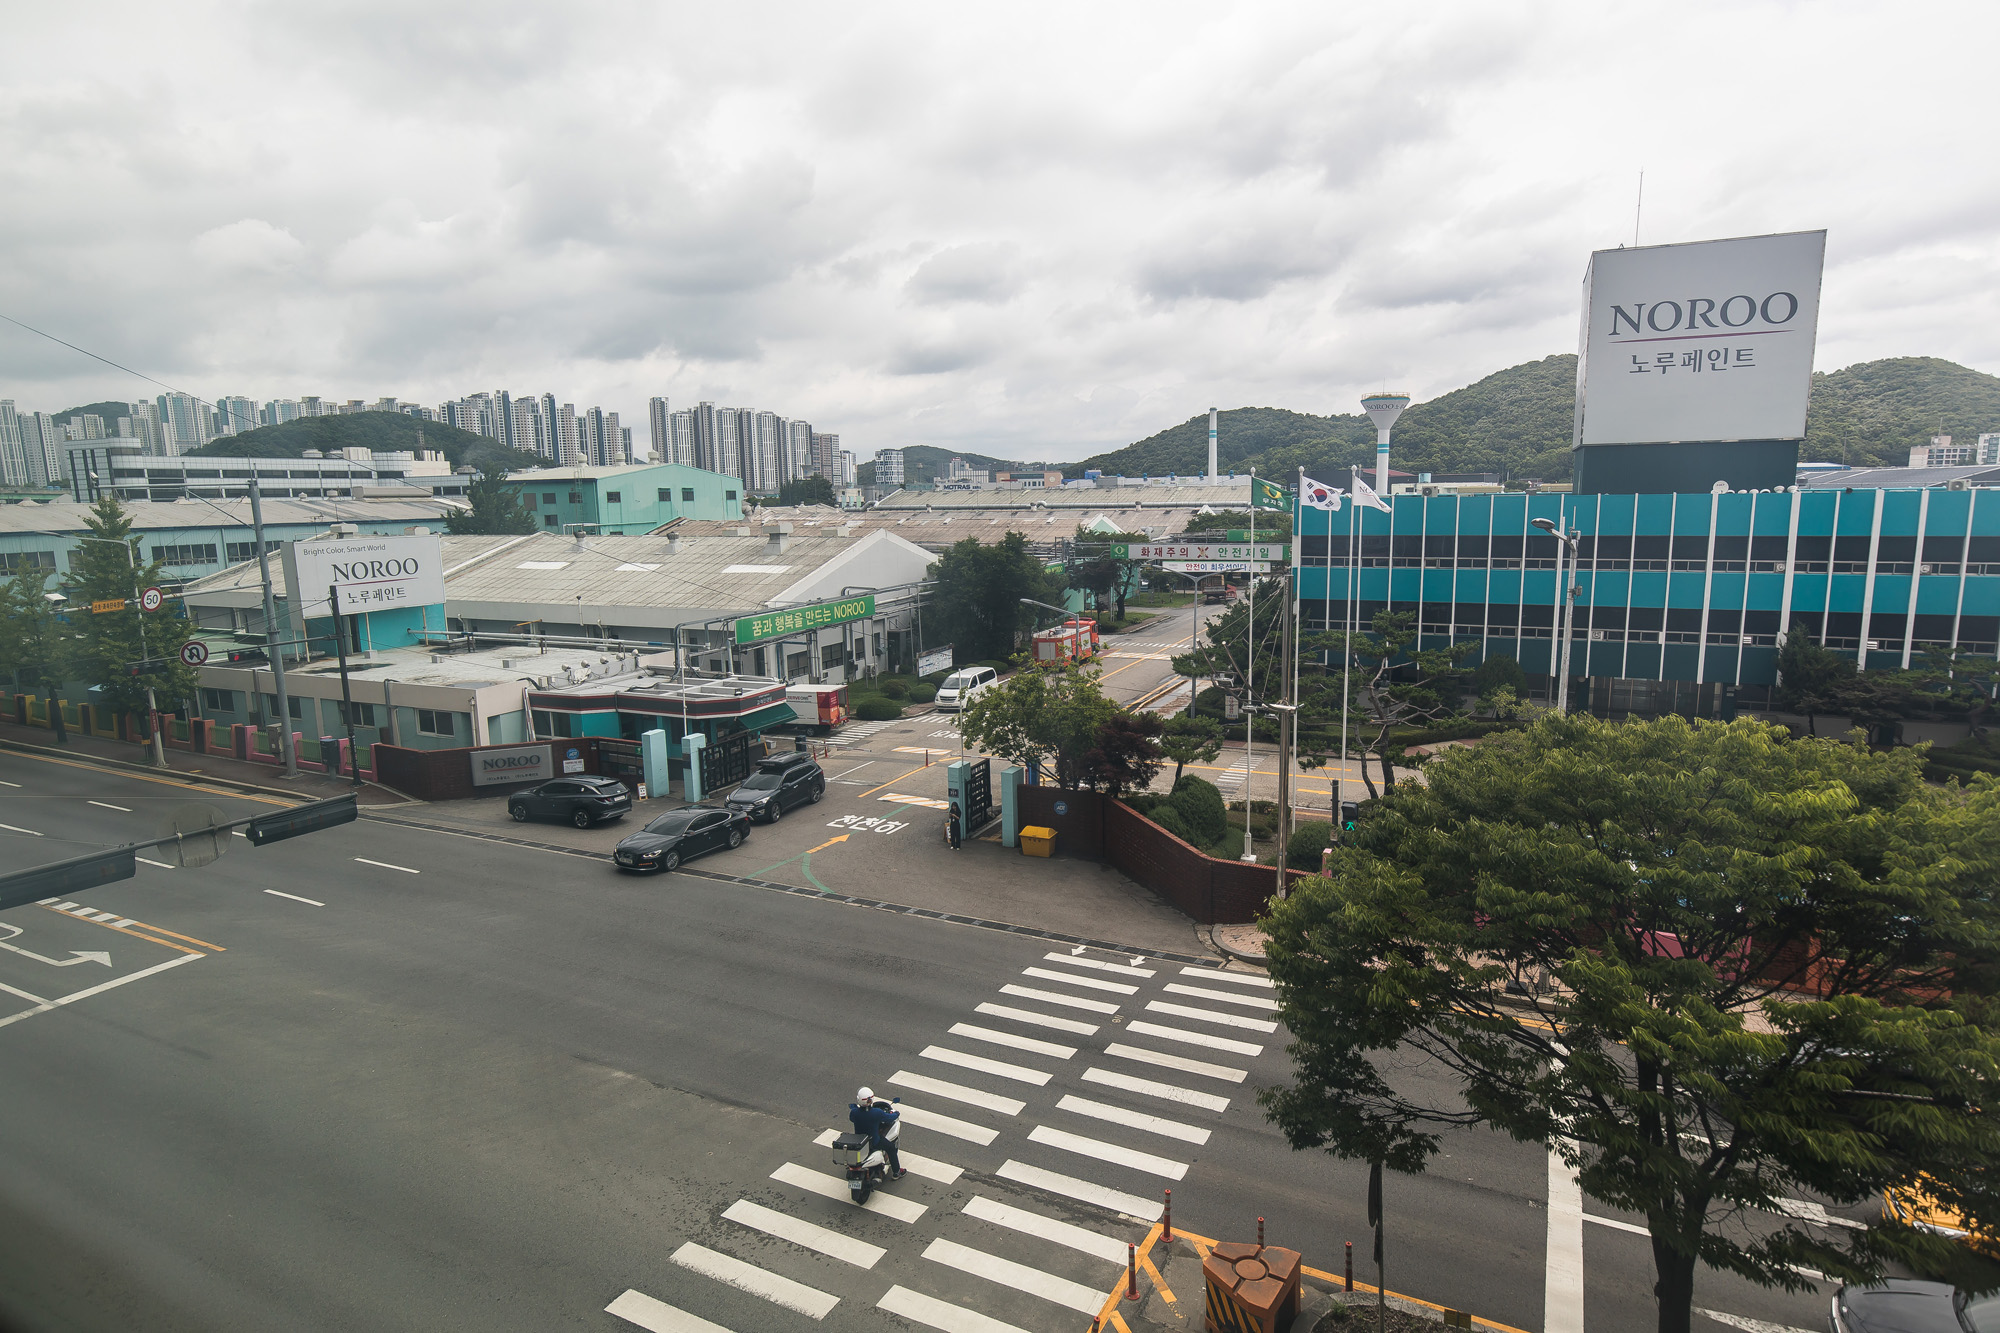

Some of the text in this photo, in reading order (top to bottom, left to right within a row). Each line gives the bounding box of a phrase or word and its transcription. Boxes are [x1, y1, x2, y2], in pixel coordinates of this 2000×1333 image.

[1608, 292, 1799, 336] NOROO
[1629, 348, 1756, 375] 노루페인트
[303, 548, 325, 557] Bright
[326, 546, 346, 555] Color,
[1140, 547, 1269, 559] 화재주의 안전제일
[331, 557, 419, 582] NOROO
[1185, 562, 1207, 571] 안전이
[146, 594, 159, 605] 50
[347, 587, 407, 604] 노루페인트
[752, 601, 866, 637] 꿈과 행복을 만드는 NOROO
[482, 755, 541, 771] NOROO
[826, 814, 910, 835] 천천히
